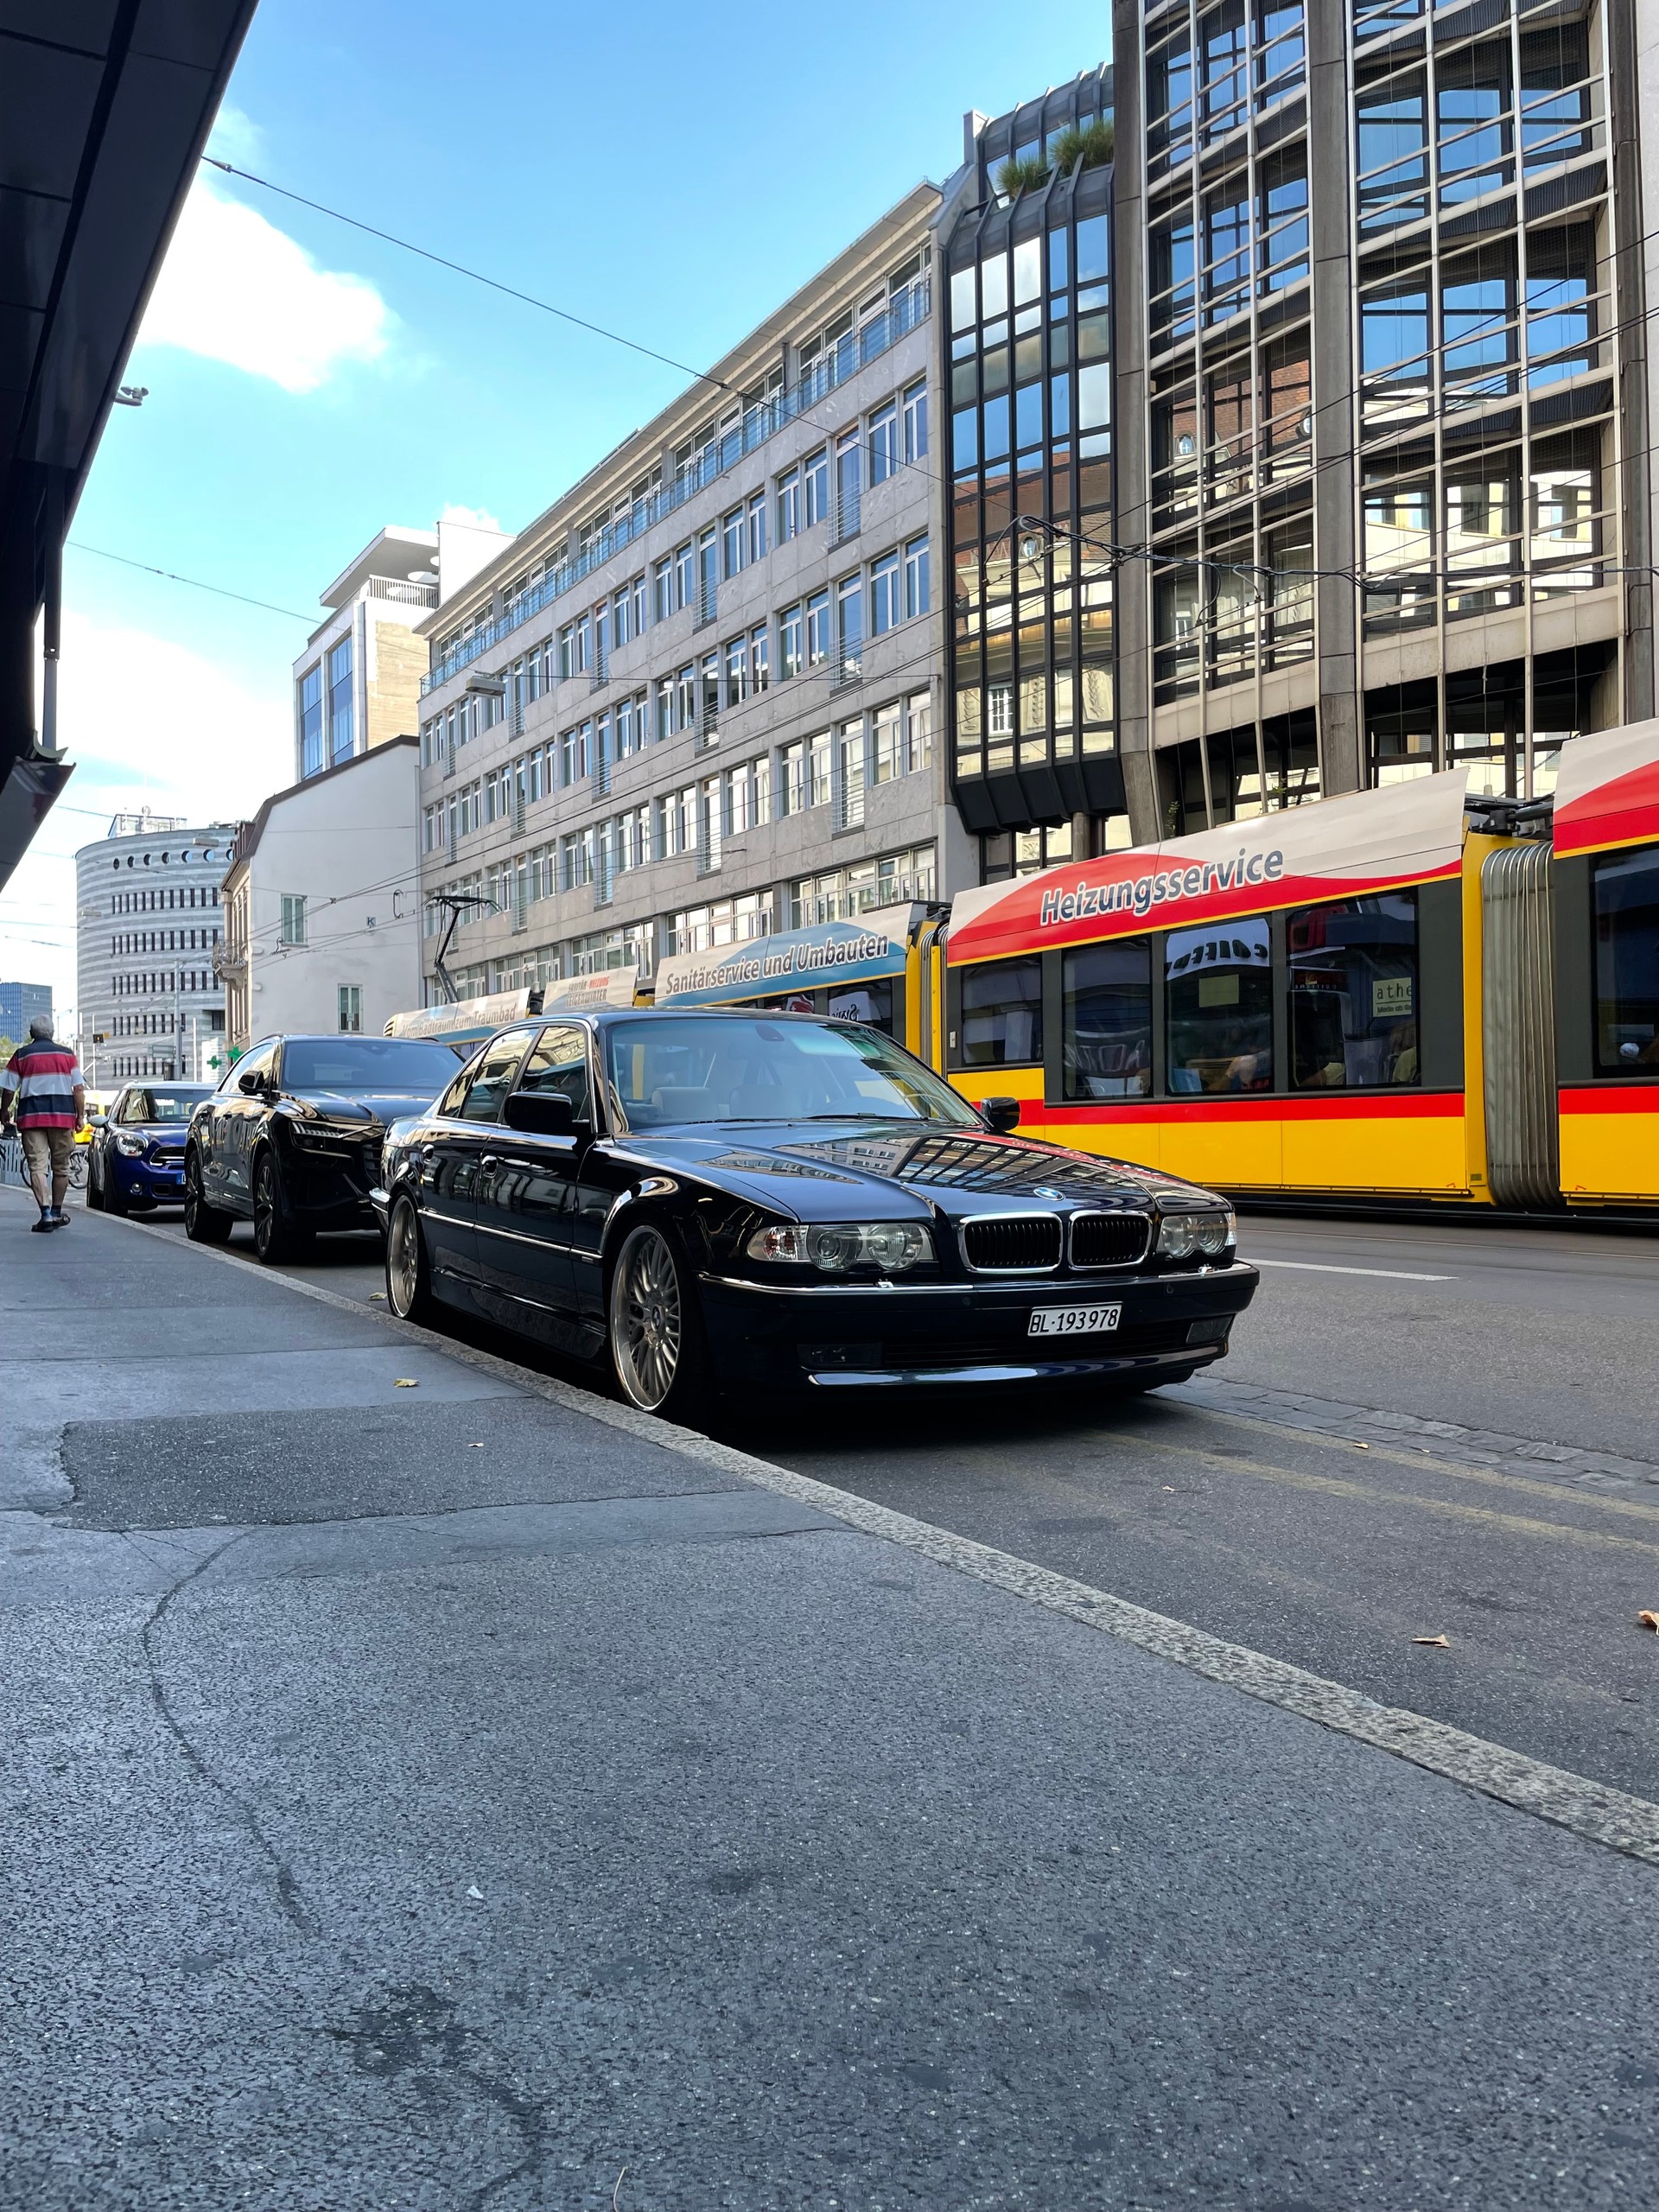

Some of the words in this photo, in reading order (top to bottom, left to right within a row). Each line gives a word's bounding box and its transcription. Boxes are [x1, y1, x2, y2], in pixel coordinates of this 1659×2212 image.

[1042, 848, 1284, 924] Heizungsservice
[367, 917, 374, 926] K
[666, 959, 760, 995] Sanitärservice
[763, 945, 794, 978] und
[798, 934, 889, 970] Umbauten
[474, 1002, 517, 1027] Traumbad
